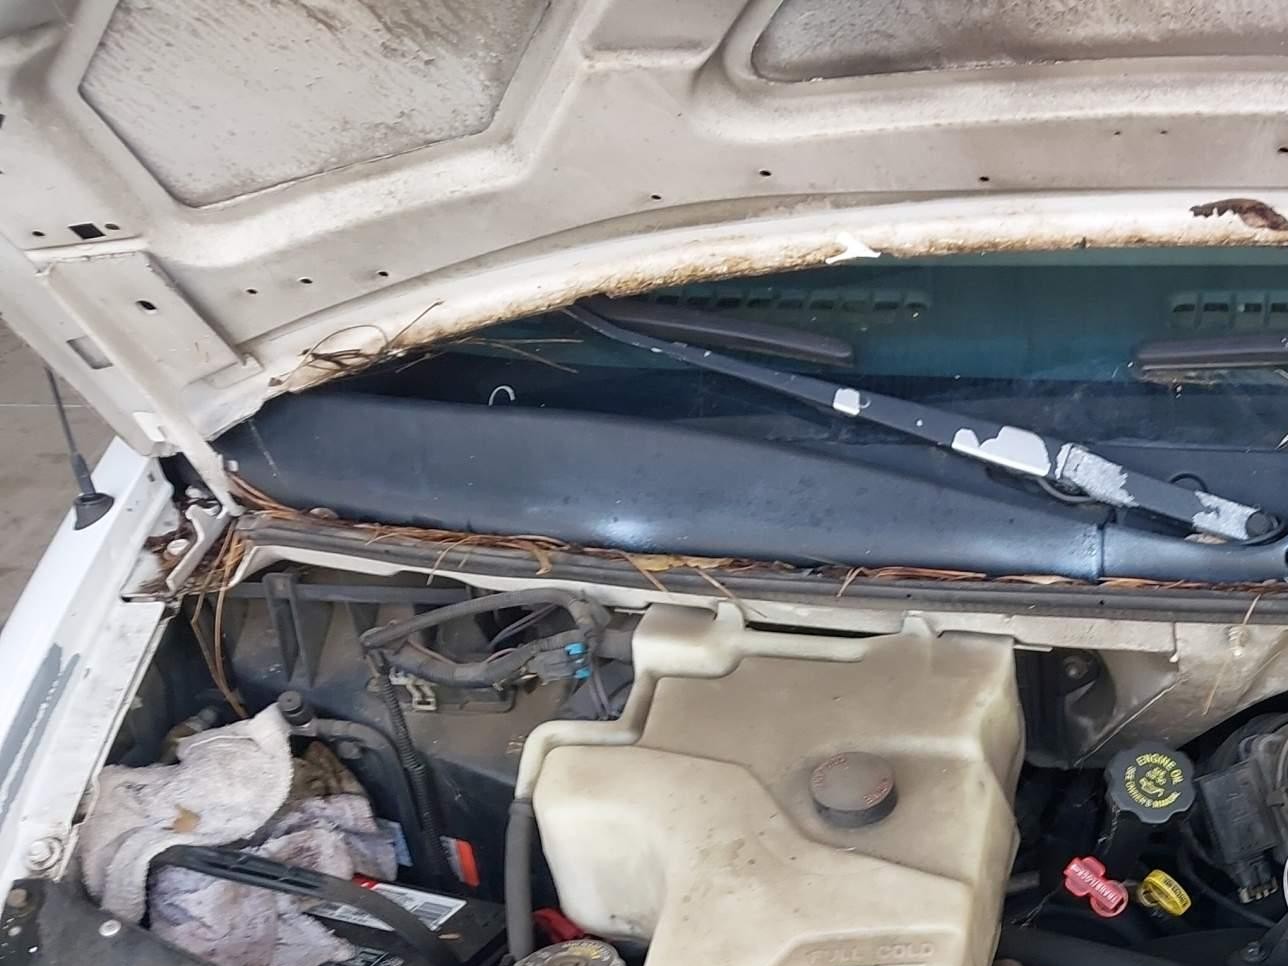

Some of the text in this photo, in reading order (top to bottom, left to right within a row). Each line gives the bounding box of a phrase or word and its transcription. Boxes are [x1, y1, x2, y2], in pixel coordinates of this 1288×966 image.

[1136, 753, 1185, 785] ENGINE OIL
[878, 941, 936, 960] COLD
